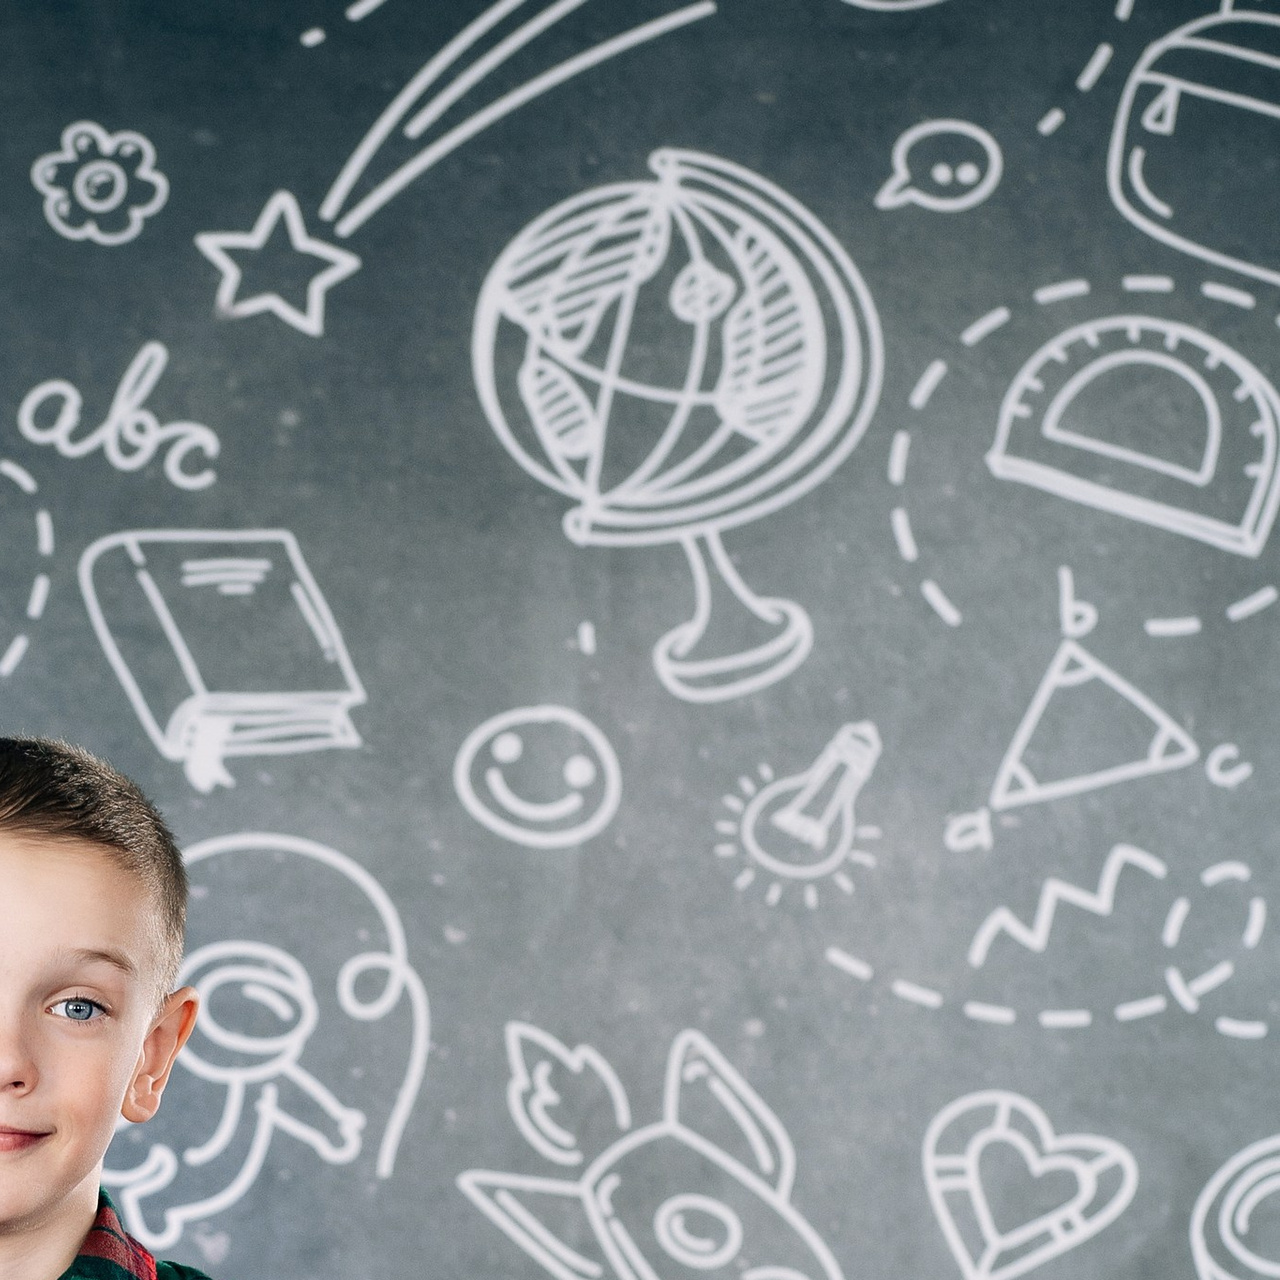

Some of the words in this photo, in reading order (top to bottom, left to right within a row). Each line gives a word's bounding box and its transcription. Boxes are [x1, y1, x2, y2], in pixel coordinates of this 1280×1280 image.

[18, 341, 220, 490] abc
[1057, 565, 1098, 639] b
[1205, 743, 1253, 788] c
